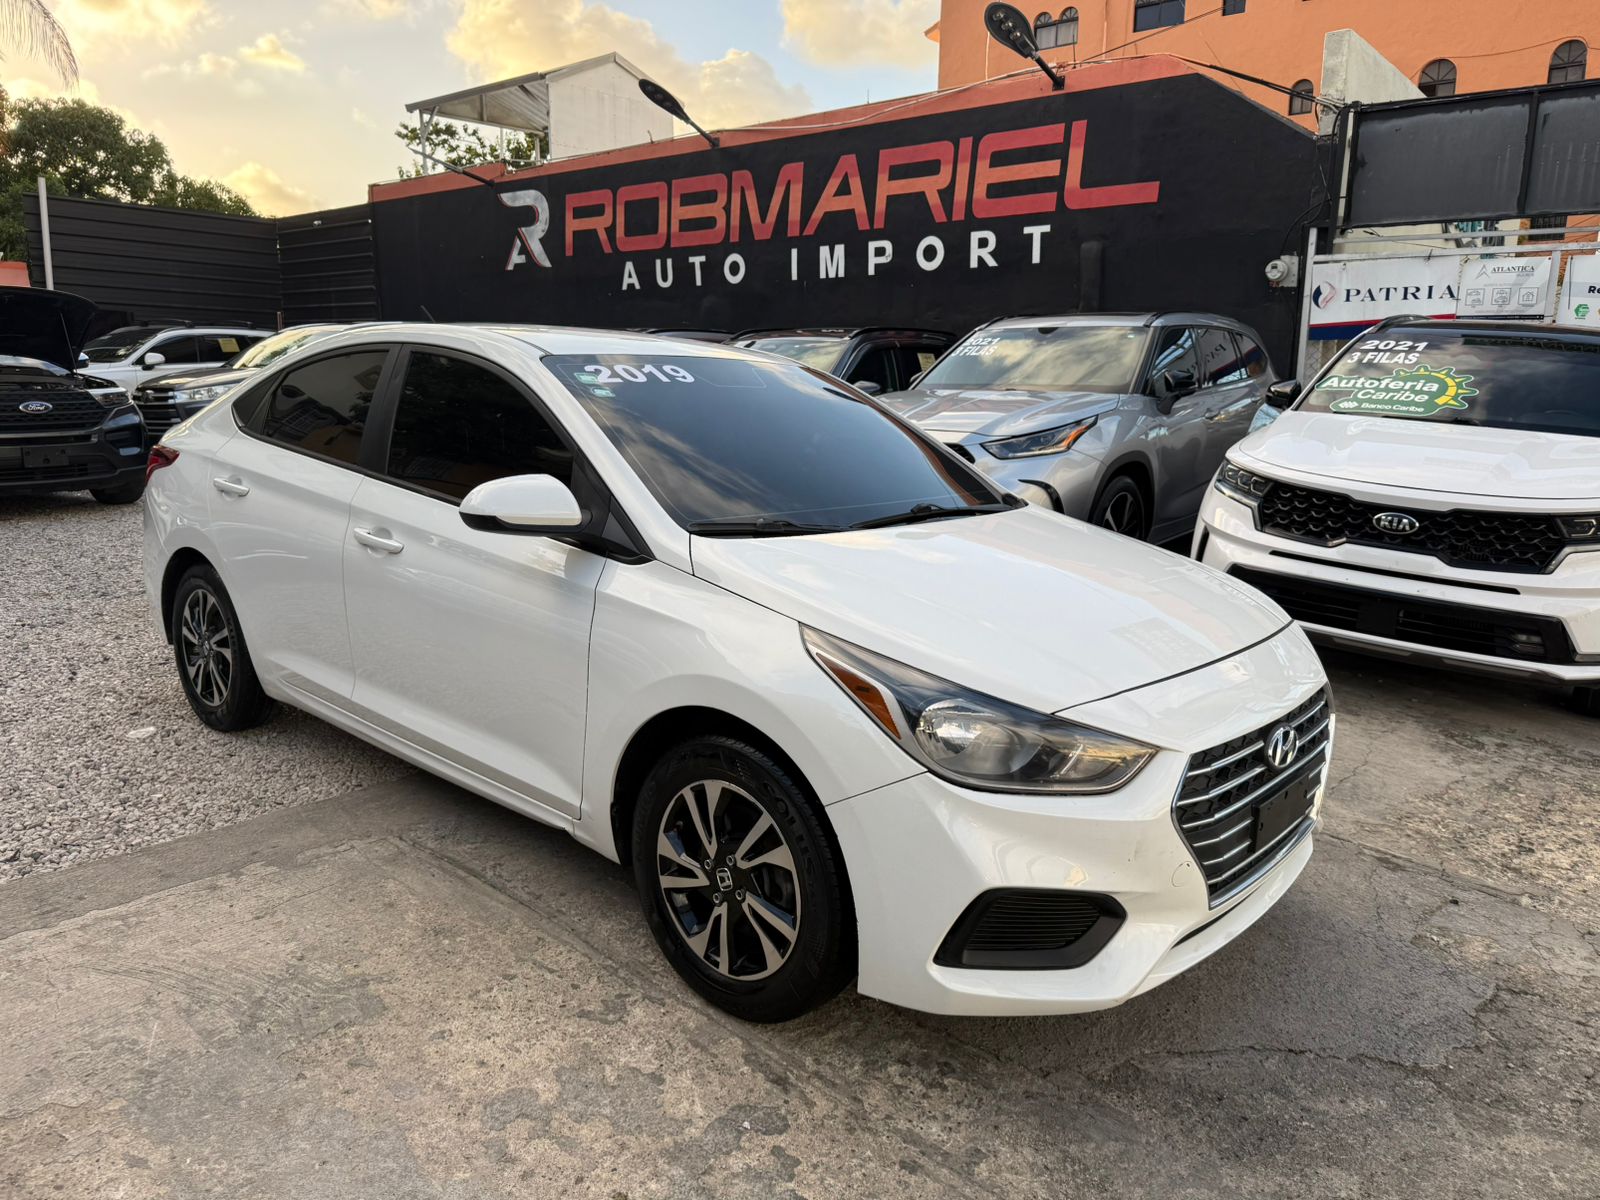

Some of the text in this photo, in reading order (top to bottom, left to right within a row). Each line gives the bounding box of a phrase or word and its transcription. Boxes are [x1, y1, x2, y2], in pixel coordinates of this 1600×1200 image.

[565, 119, 1160, 257] ROBMARIEL
[621, 224, 1052, 291] AUTO IMPORT
[1491, 265, 1535, 273] ATLANTICA
[1344, 284, 1457, 302] PATRIA
[960, 345, 998, 356] FILAS
[1360, 340, 1429, 351] 2021
[1347, 352, 1420, 364] 3 FILAS
[584, 364, 695, 383] 2019
[1322, 376, 1440, 393] Autoferia
[1356, 389, 1430, 403] Caribe
[1360, 402, 1425, 413] Banco Caribe
[1380, 515, 1411, 531] KIA
